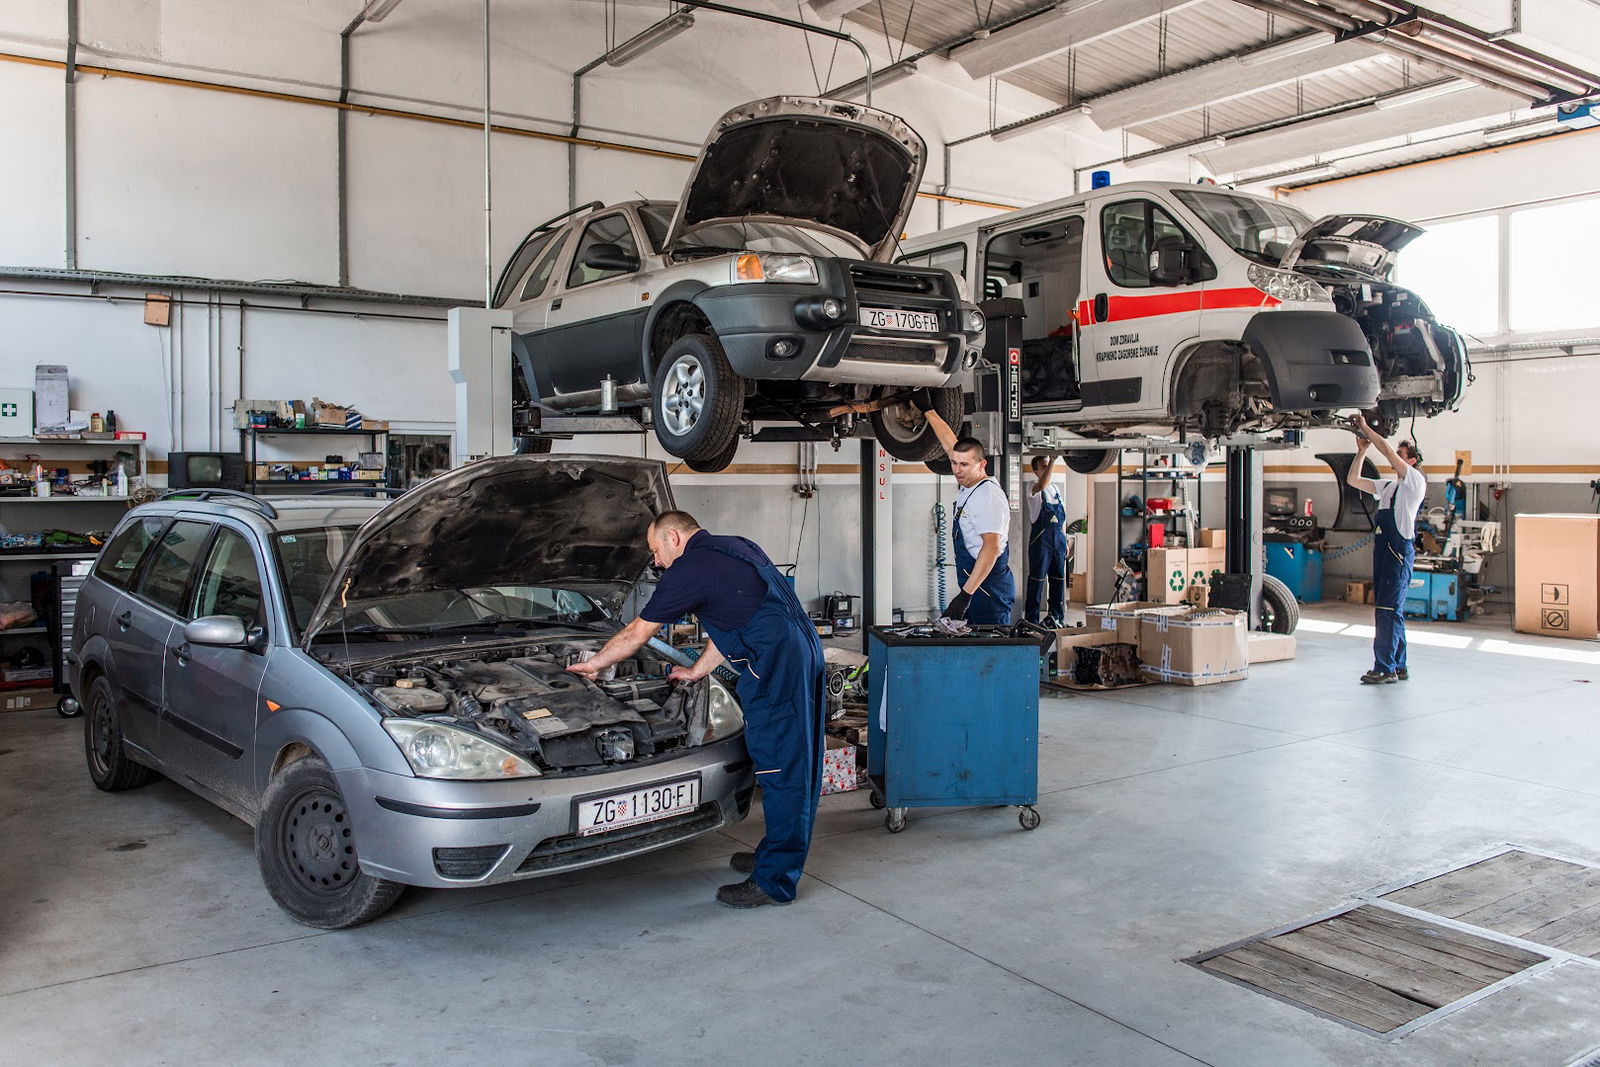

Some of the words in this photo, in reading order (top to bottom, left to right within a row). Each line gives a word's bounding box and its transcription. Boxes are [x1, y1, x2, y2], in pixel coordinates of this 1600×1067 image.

[869, 311, 886, 327] ZG
[1110, 335, 1119, 346] DOM
[1119, 333, 1139, 345] ZDRAVLJA
[1096, 350, 1118, 362] KRAPINSKO
[1118, 347, 1139, 360] ZAGORSKE
[1139, 345, 1158, 357] ŽUPANIJE
[593, 800, 616, 825] ZG
